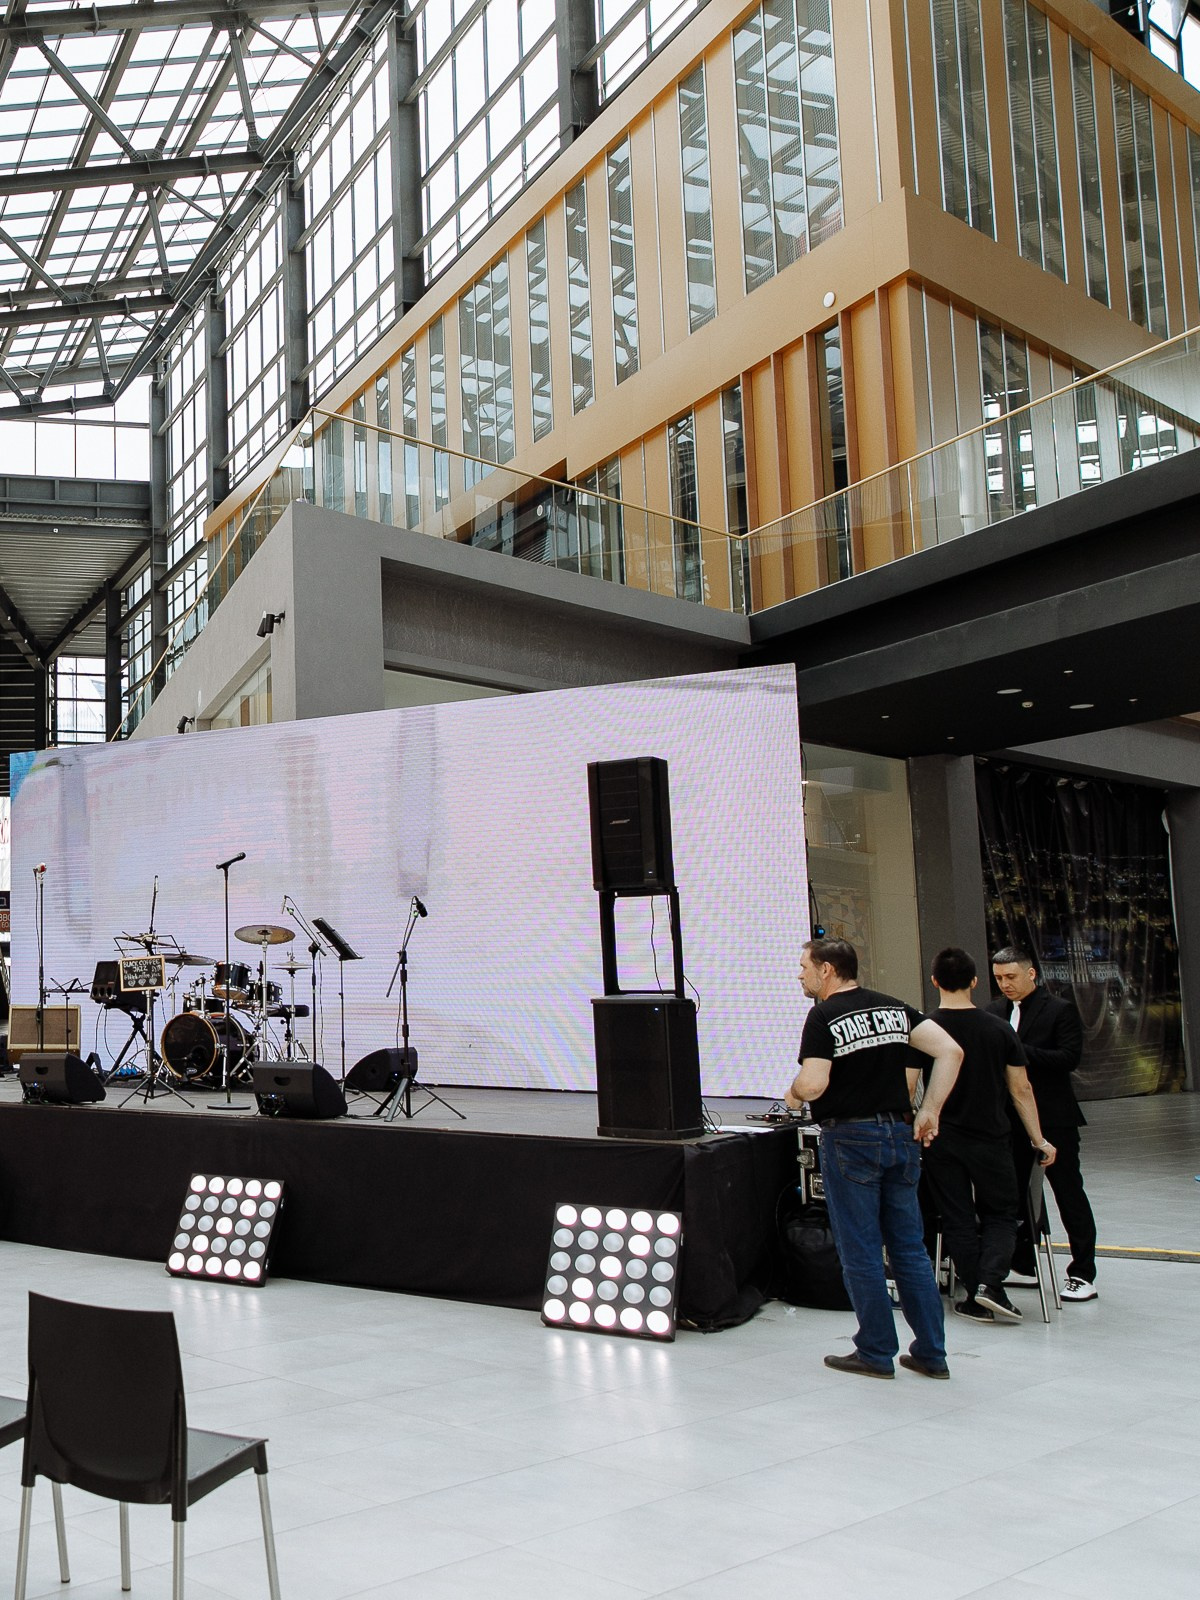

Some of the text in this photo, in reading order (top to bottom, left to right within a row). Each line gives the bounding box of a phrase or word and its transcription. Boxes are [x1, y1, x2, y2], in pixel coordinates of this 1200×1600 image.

[123, 958, 161, 968] BLACK COFFEE
[829, 1009, 908, 1046] STAGE CREW
